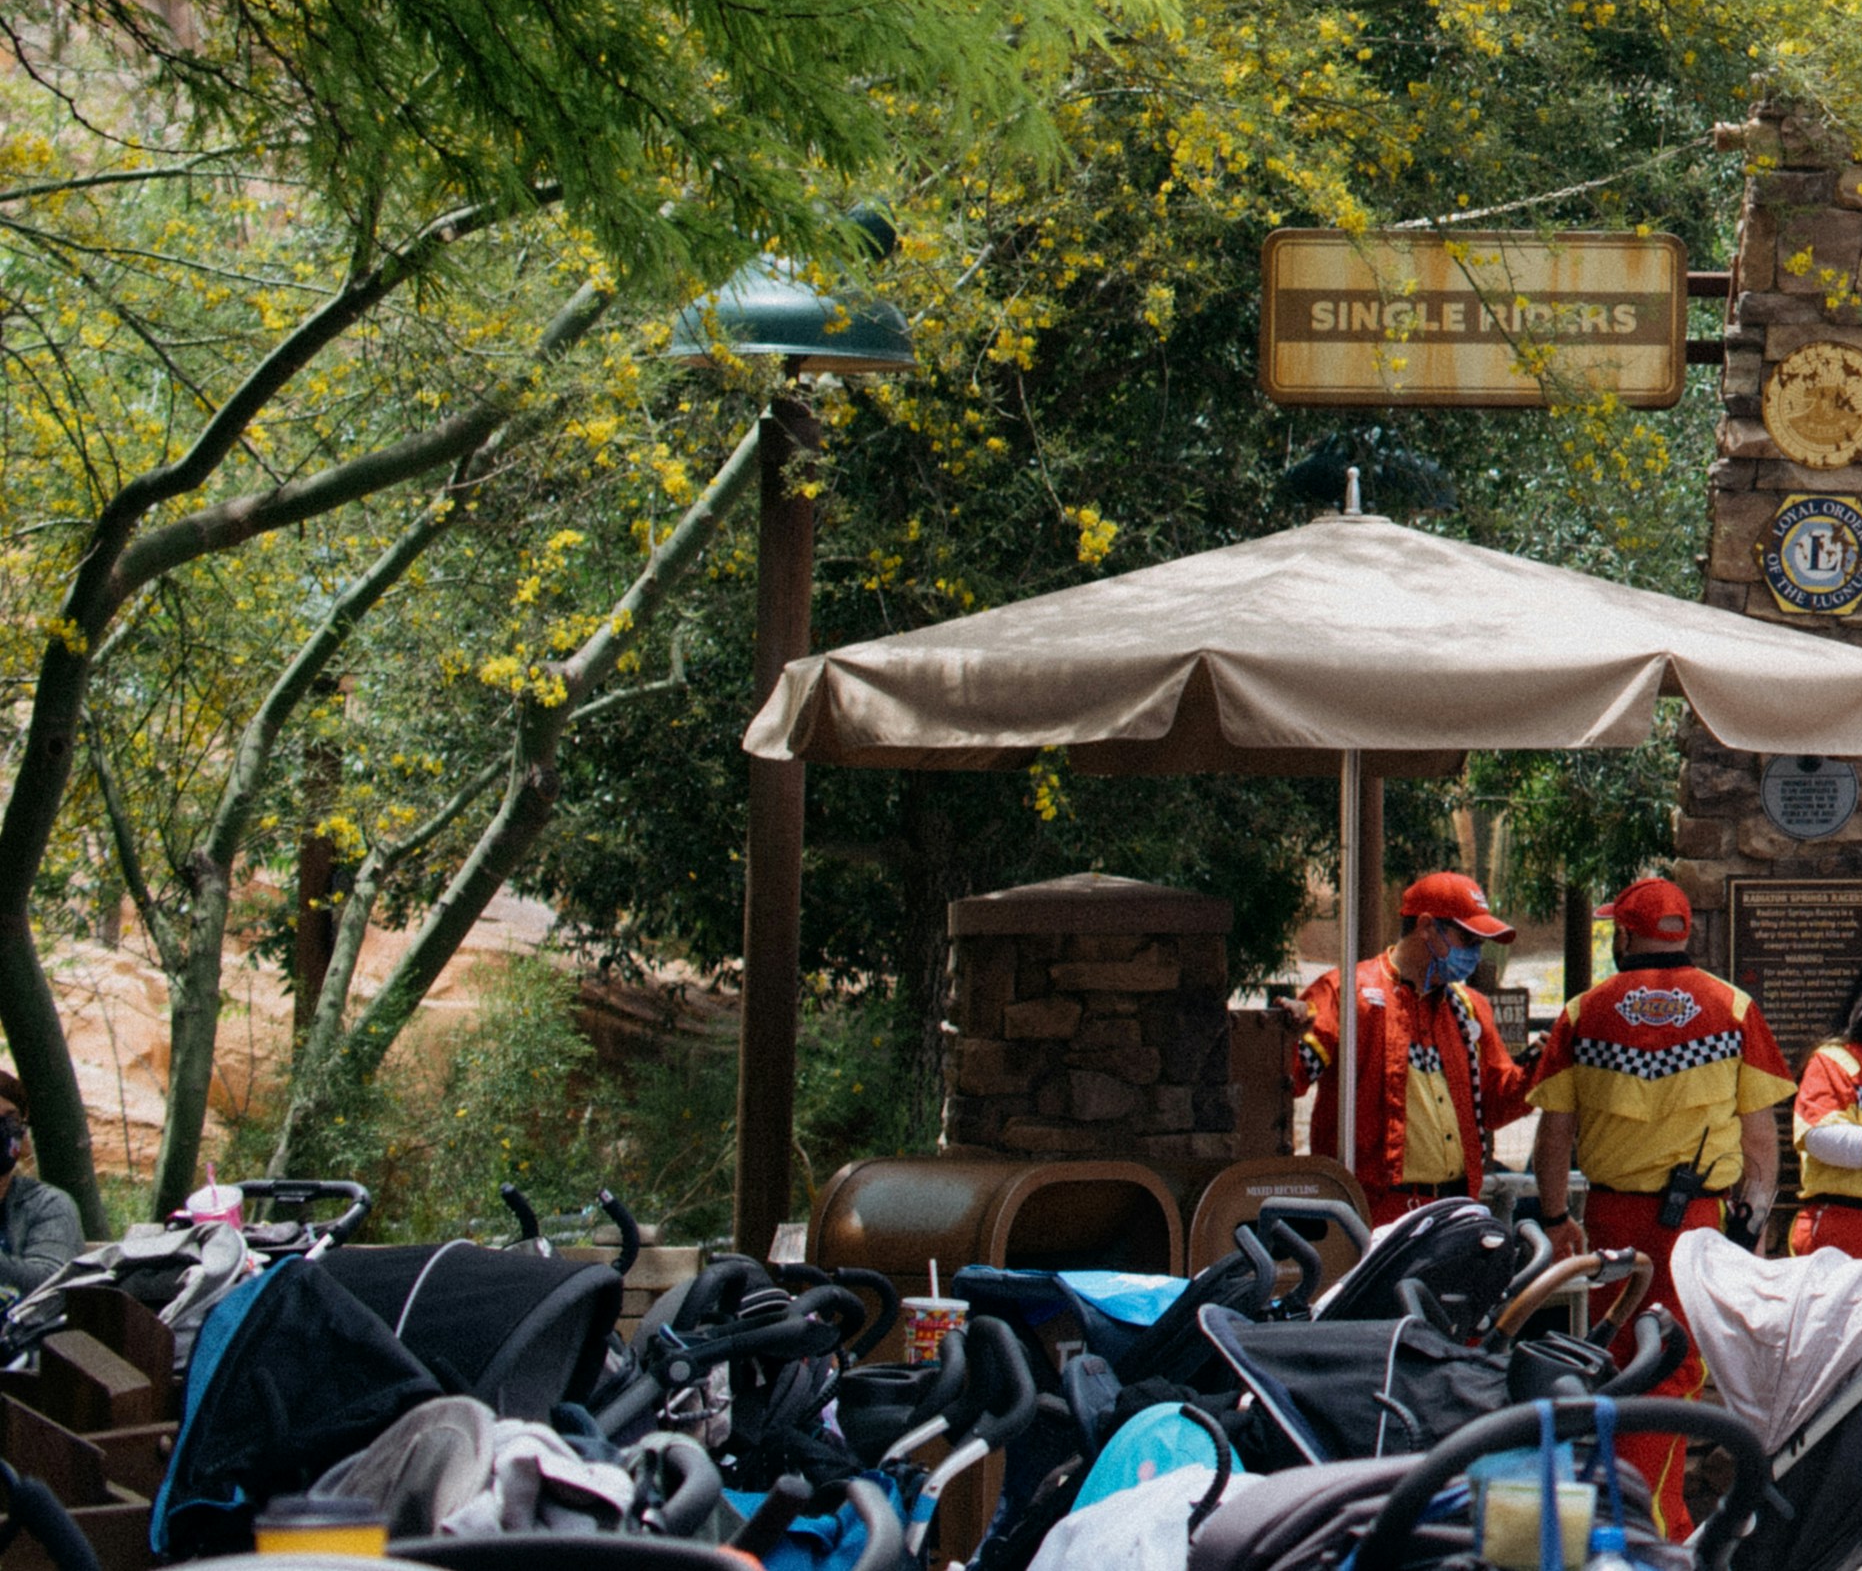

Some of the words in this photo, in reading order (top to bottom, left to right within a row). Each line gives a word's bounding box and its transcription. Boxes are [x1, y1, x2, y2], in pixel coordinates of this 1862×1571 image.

[1310, 300, 1467, 333] SINGLE
[1772, 501, 1820, 538] LOYAL
[1767, 552, 1781, 575] OF
[1776, 578, 1807, 606] THE
